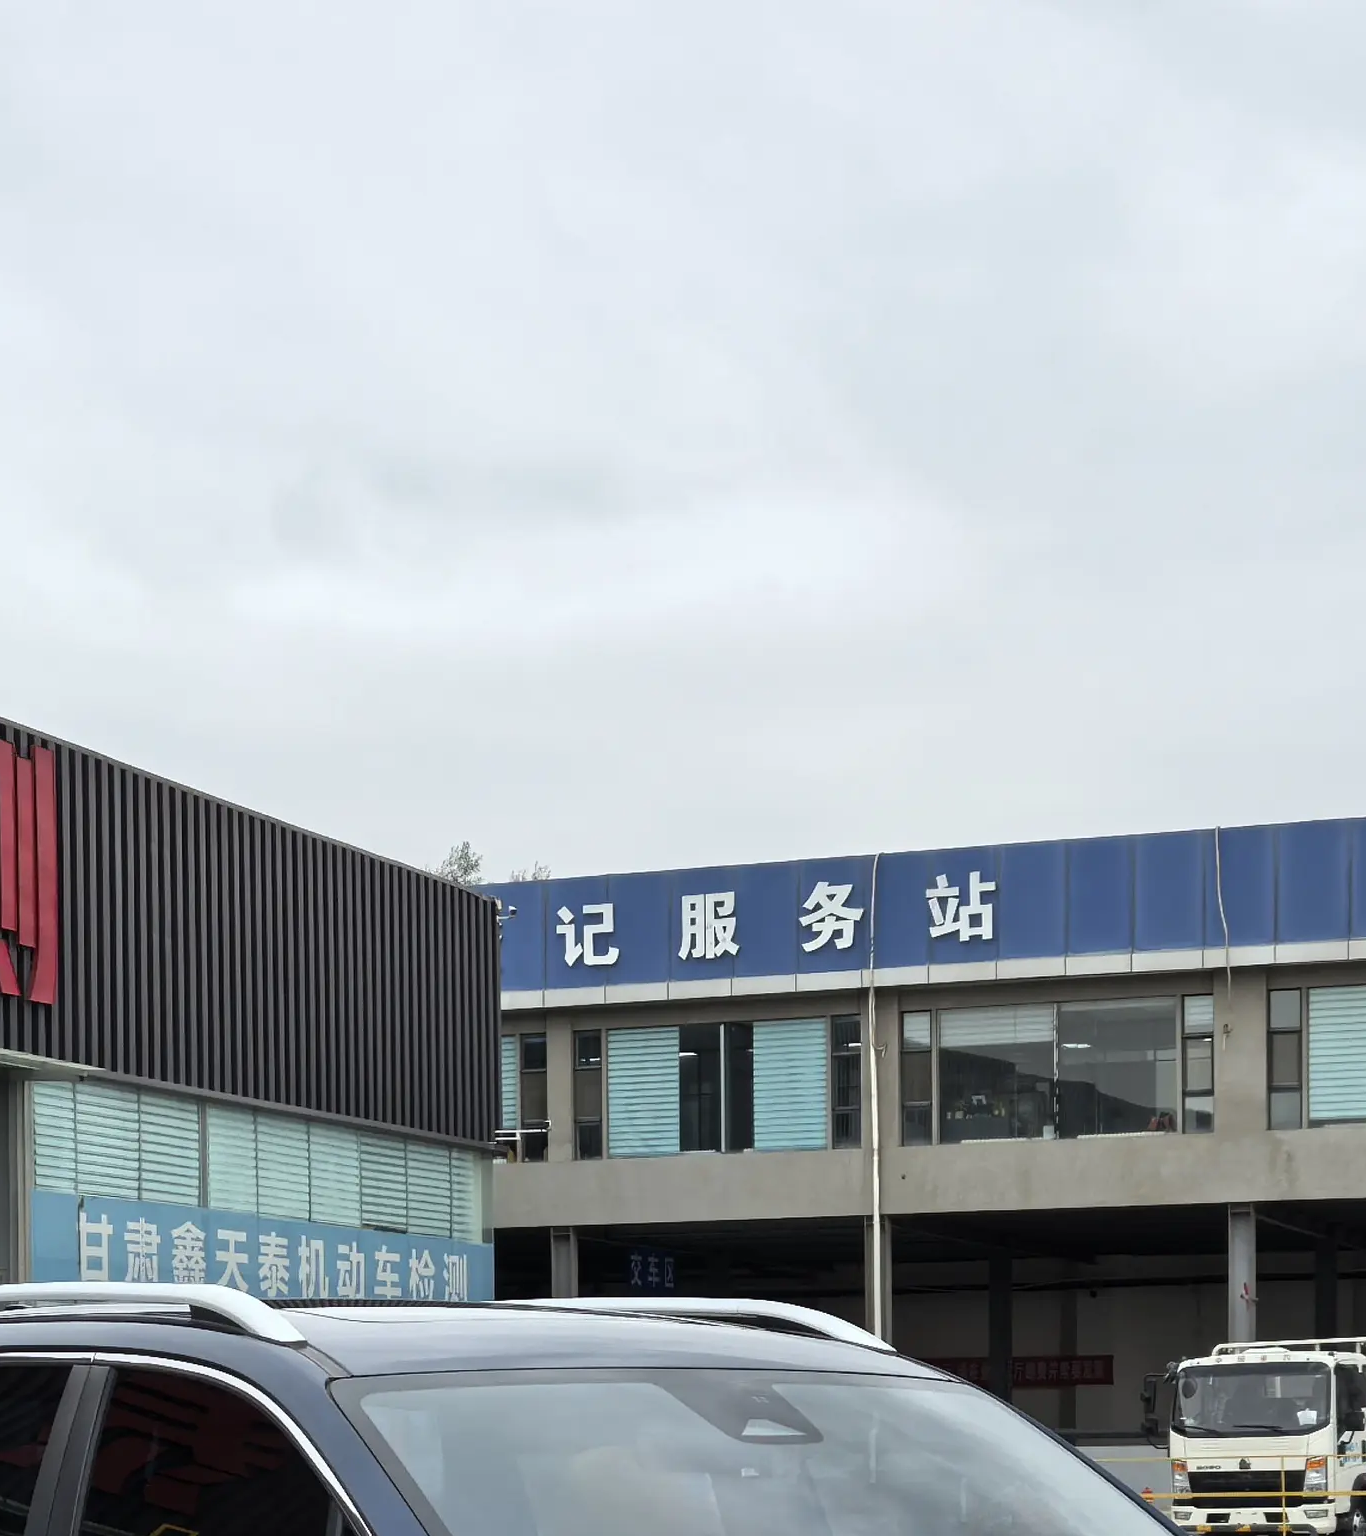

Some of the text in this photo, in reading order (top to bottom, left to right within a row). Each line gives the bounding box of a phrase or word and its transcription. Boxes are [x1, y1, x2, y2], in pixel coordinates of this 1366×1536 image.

[556, 870, 998, 968] 记服务站
[79, 1210, 469, 1302] 甘肃鑫天泰机动车检测
